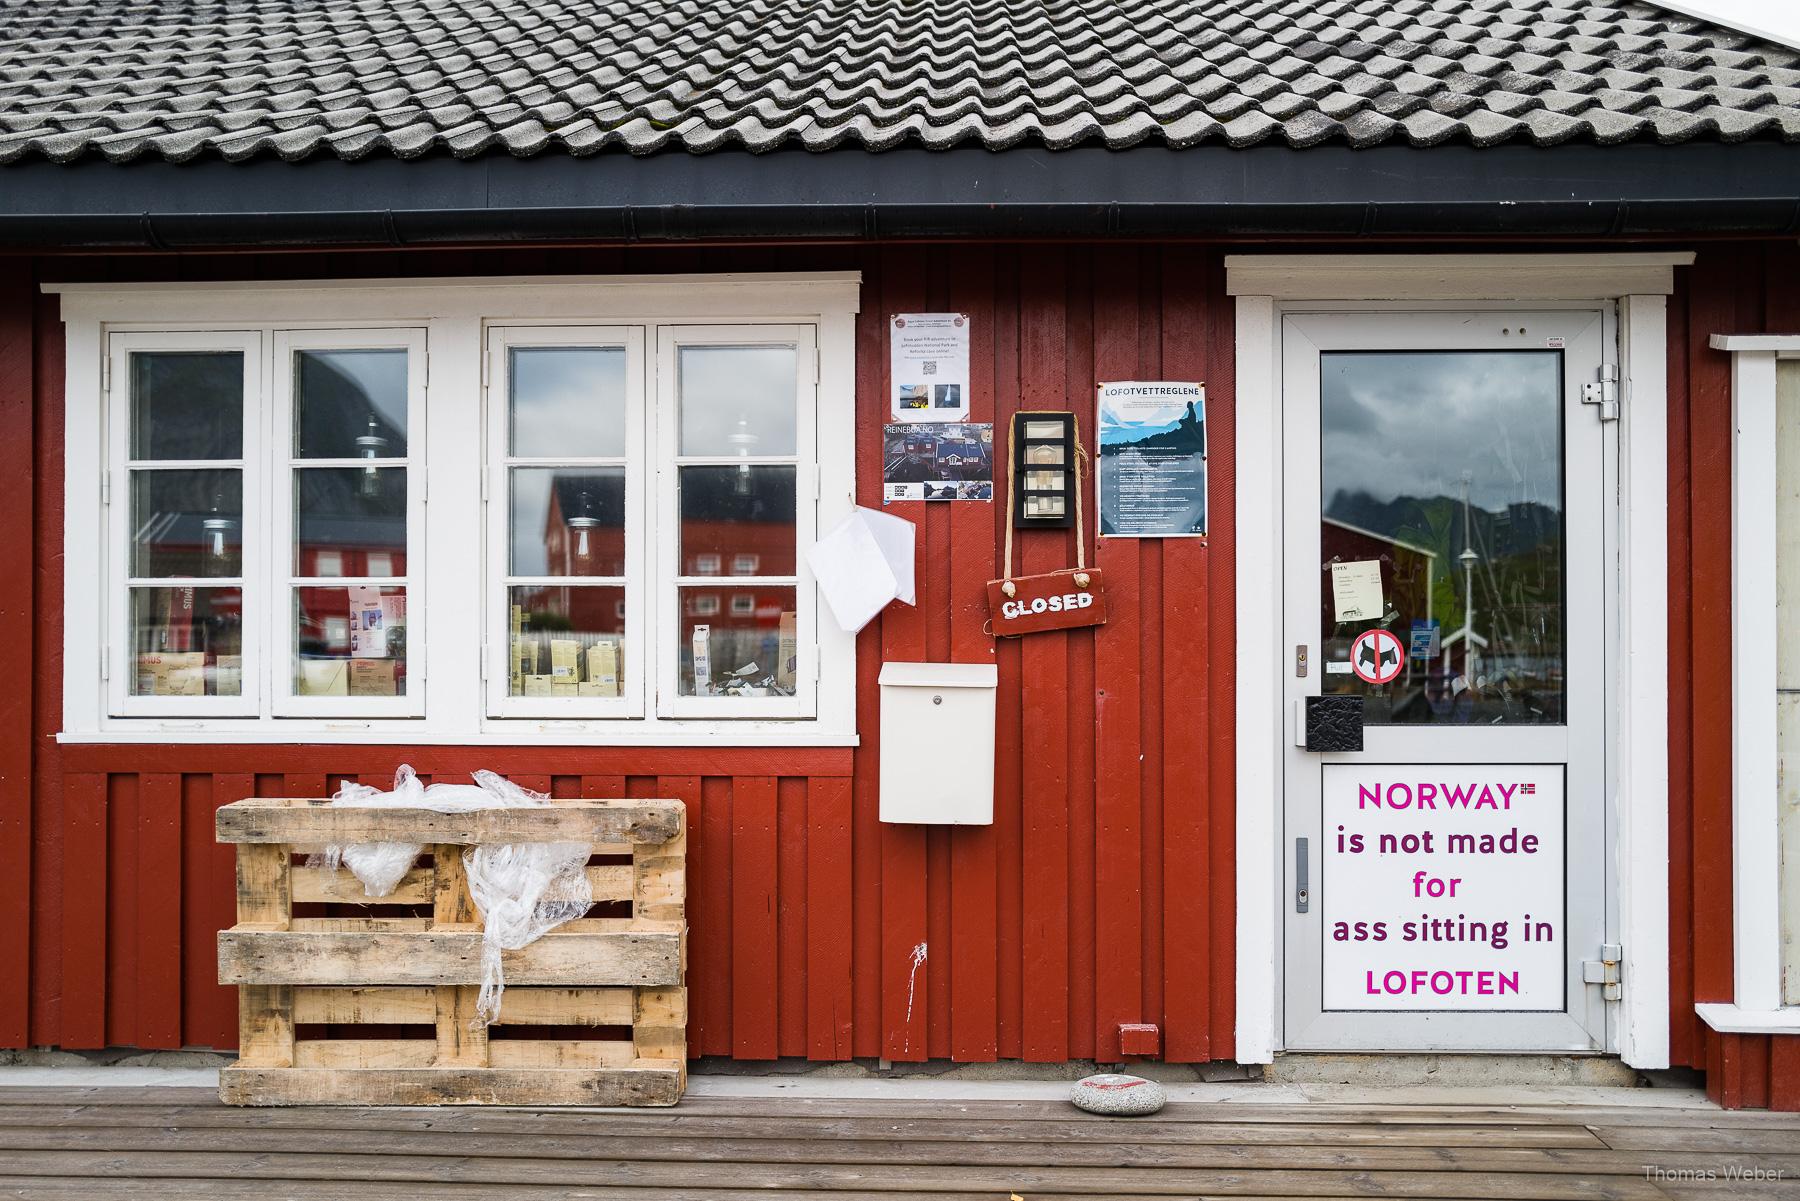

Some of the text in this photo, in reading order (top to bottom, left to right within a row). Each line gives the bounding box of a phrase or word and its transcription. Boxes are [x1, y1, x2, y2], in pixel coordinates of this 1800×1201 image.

[1105, 387, 1199, 396] LOFOTVETTREGLENE
[183, 587, 193, 609] IMUS
[1002, 592, 1094, 620] CLOSED
[138, 656, 162, 665] IMUS
[1359, 782, 1519, 810] NORWAY
[1338, 825, 1539, 854] is not made
[1413, 871, 1462, 898] for
[1333, 914, 1553, 950] ass sitting in
[1366, 970, 1519, 995] LOFOTEN
